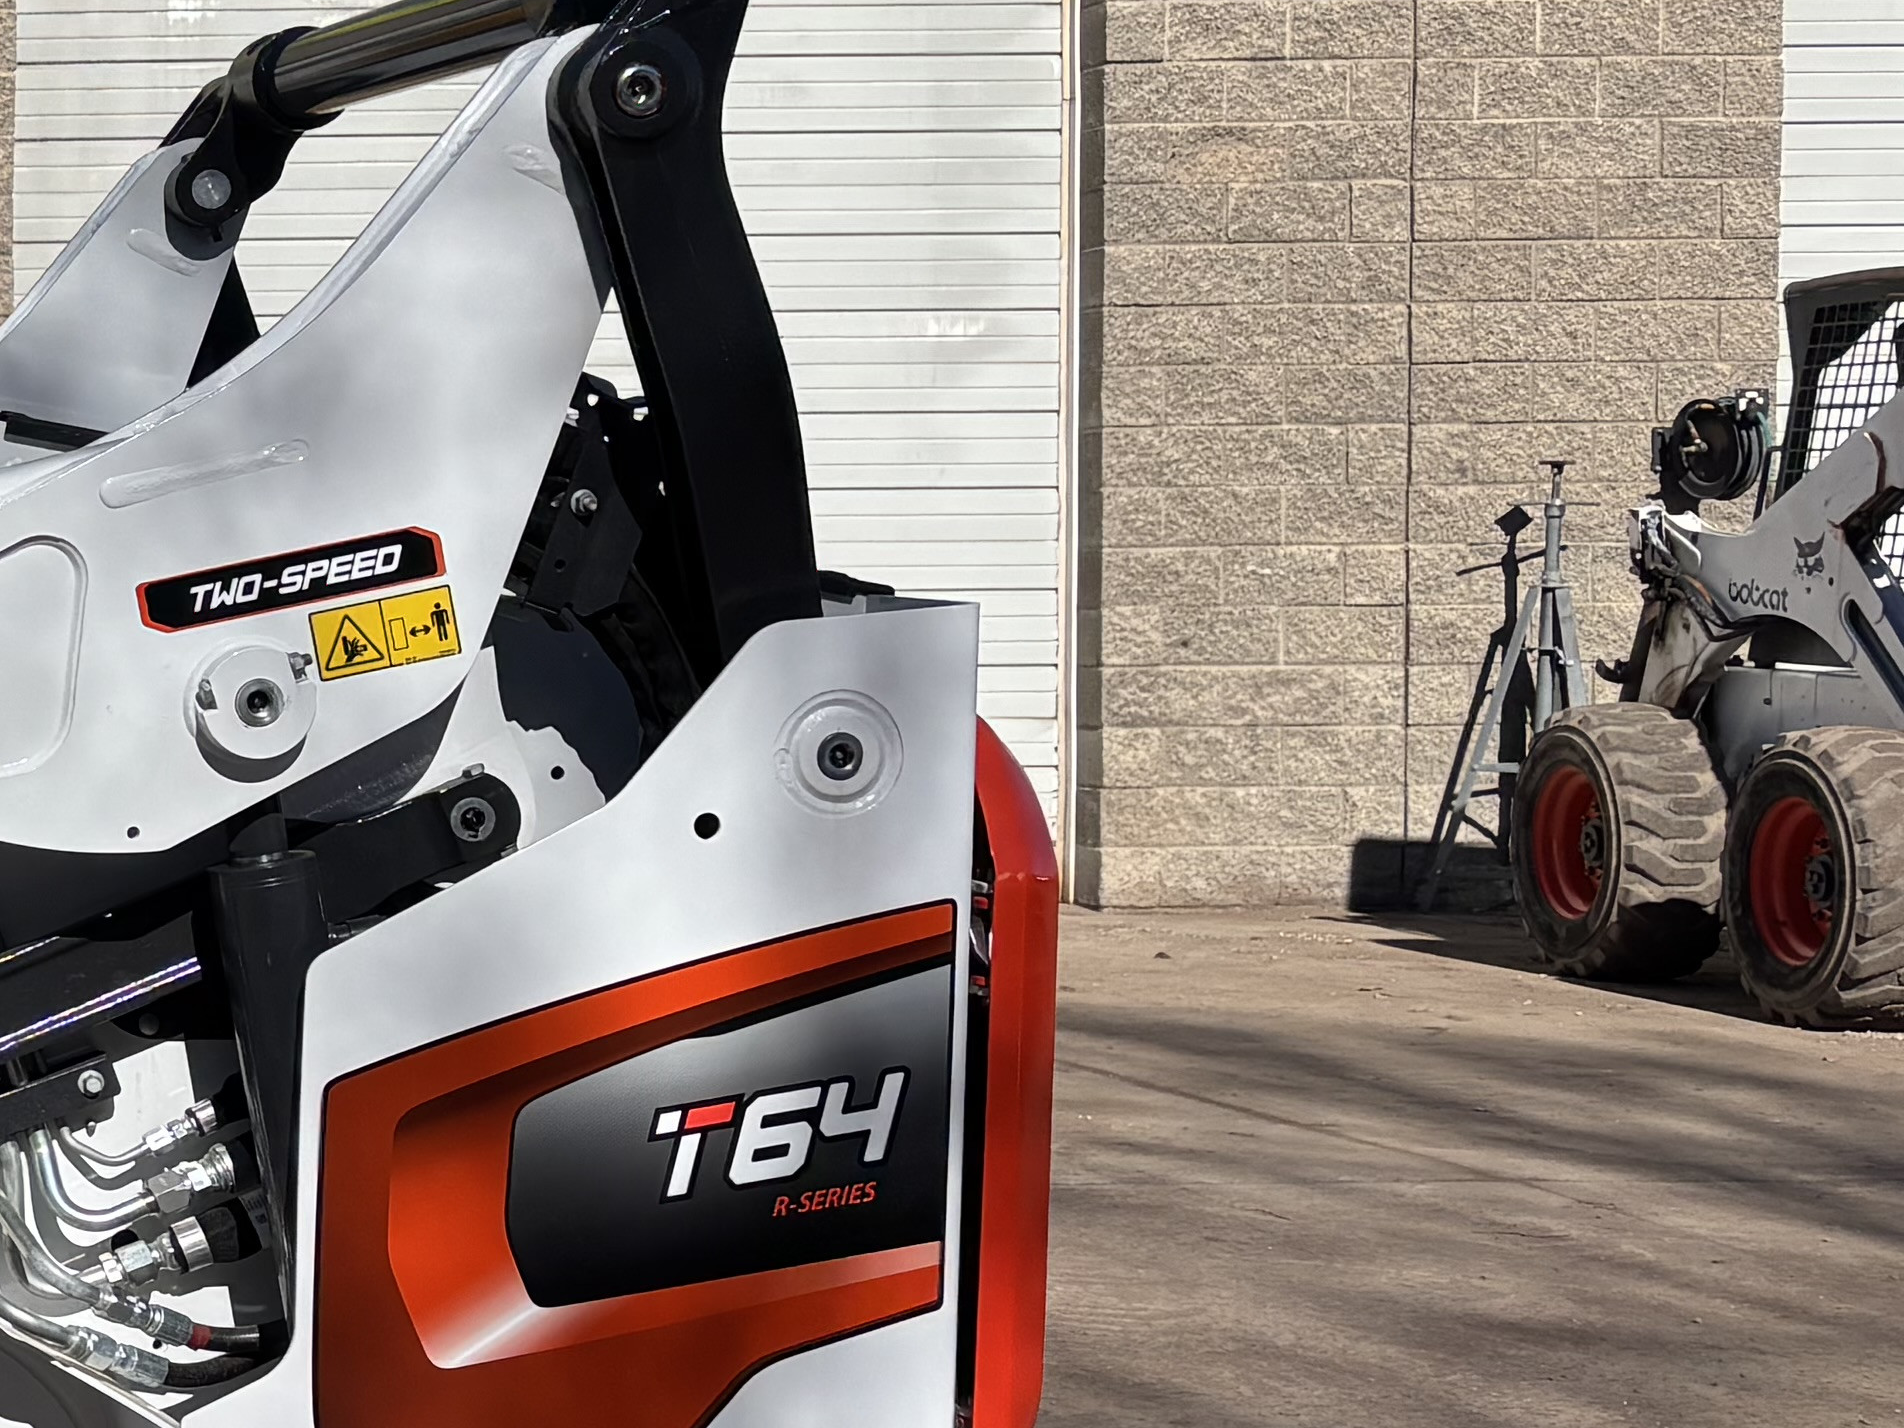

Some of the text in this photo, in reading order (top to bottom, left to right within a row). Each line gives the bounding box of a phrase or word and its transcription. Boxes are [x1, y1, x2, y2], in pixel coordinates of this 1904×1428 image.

[189, 543, 403, 613] TWO-SPEED
[653, 1070, 907, 1200] T64
[771, 1180, 877, 1218] R-SERIES
